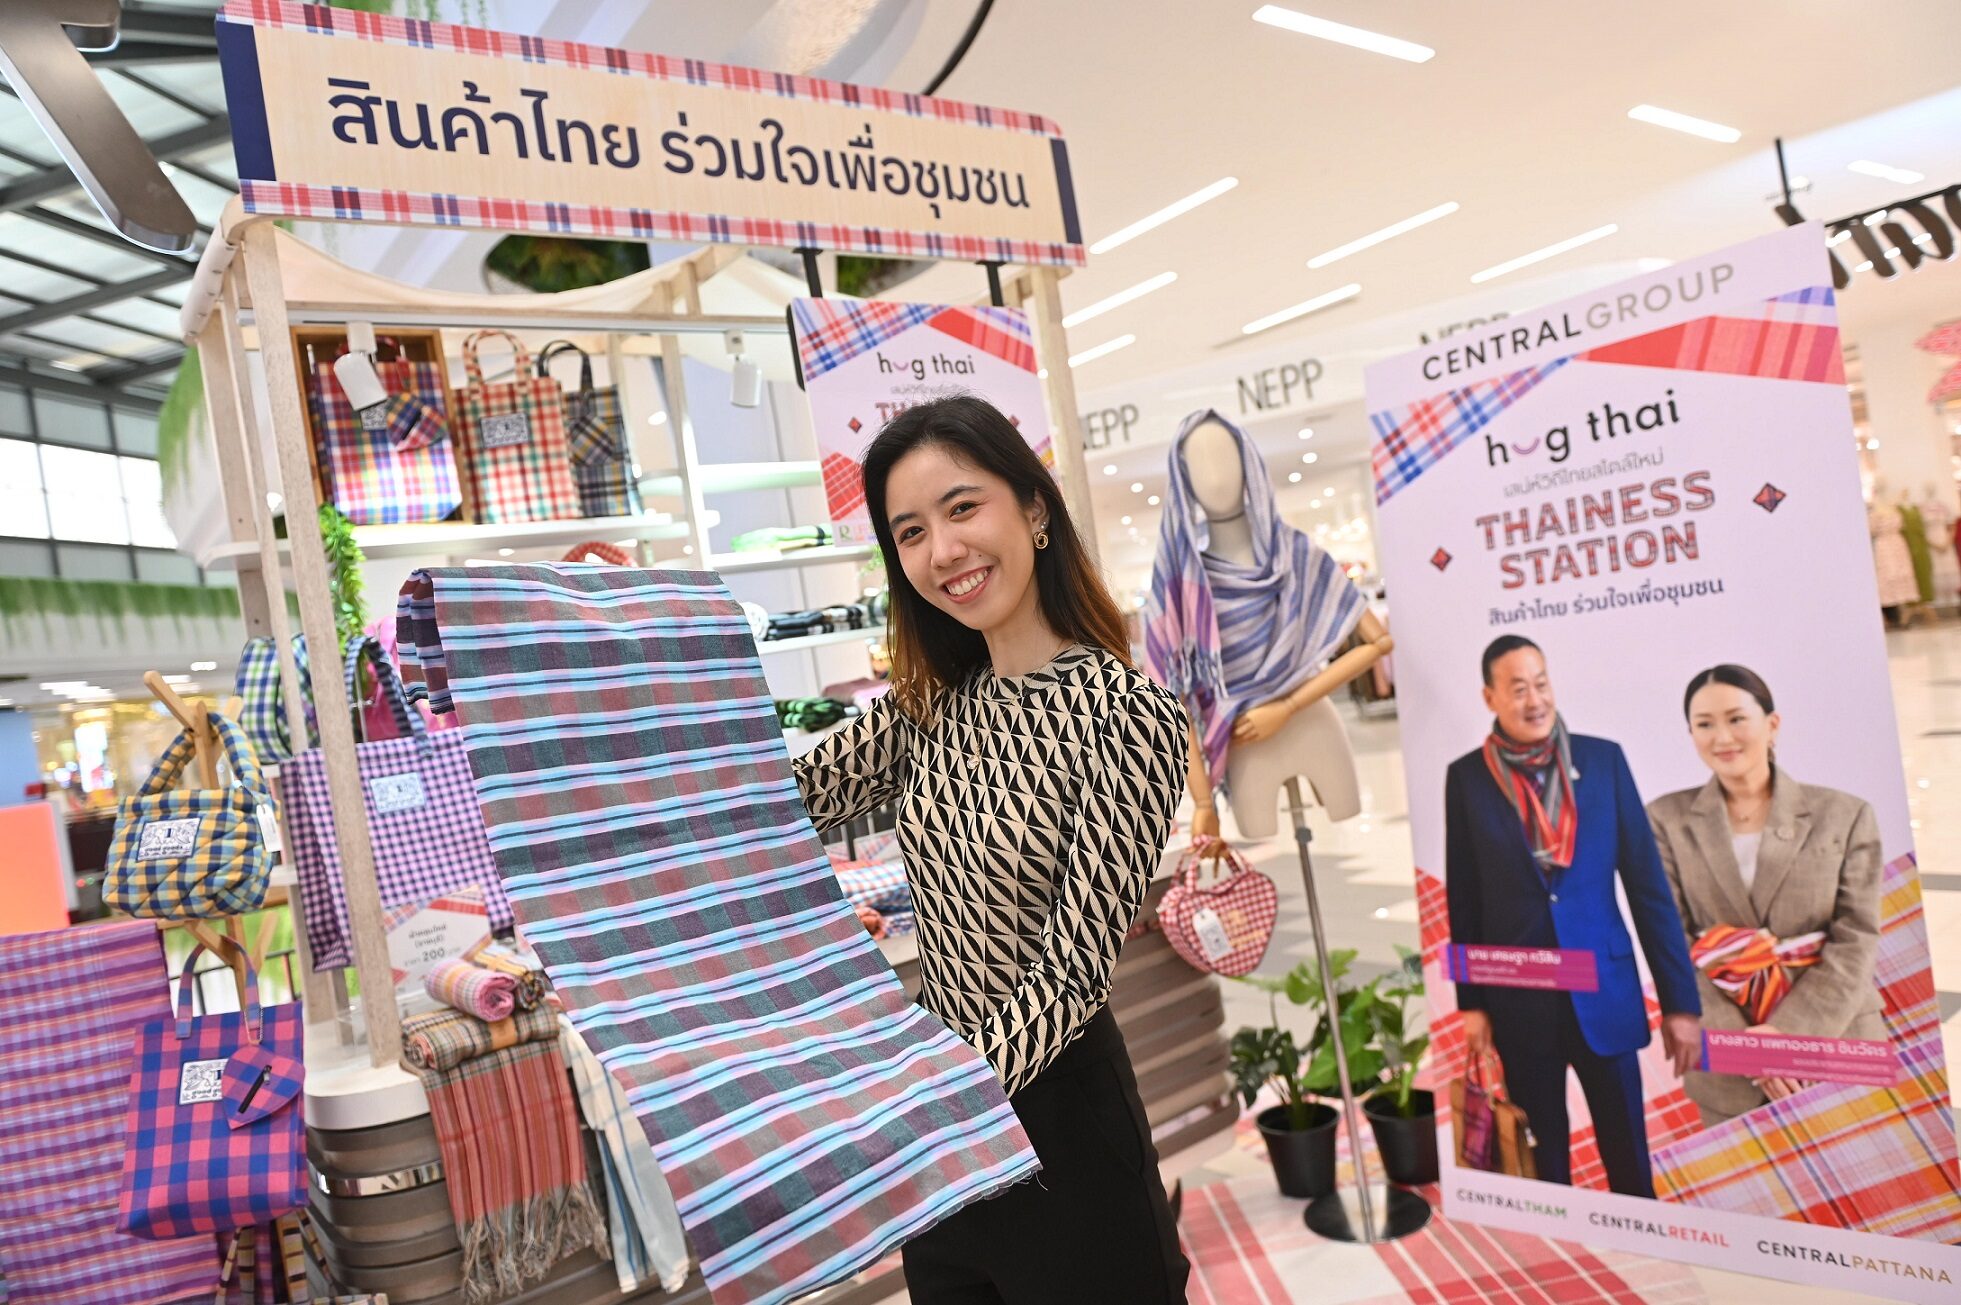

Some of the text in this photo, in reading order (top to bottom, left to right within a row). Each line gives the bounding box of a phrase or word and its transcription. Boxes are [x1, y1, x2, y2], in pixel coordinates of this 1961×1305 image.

[328, 76, 1031, 220] สินค้าไทย ร่วมใจเพื่อชุมชน
[932, 353, 976, 375] thai
[1236, 358, 1324, 416] NEPP
[1586, 389, 1681, 444] thai
[1474, 469, 1717, 552] THAINESS
[1500, 521, 1700, 590] STATION
[1489, 577, 1724, 626] สินค้าไทย ร่วมใจเพื่อชุมชน
[423, 947, 445, 962] 200
[1708, 1034, 1758, 1049] นางสาว
[1756, 1239, 1953, 1286] CENTRALPATTANA
